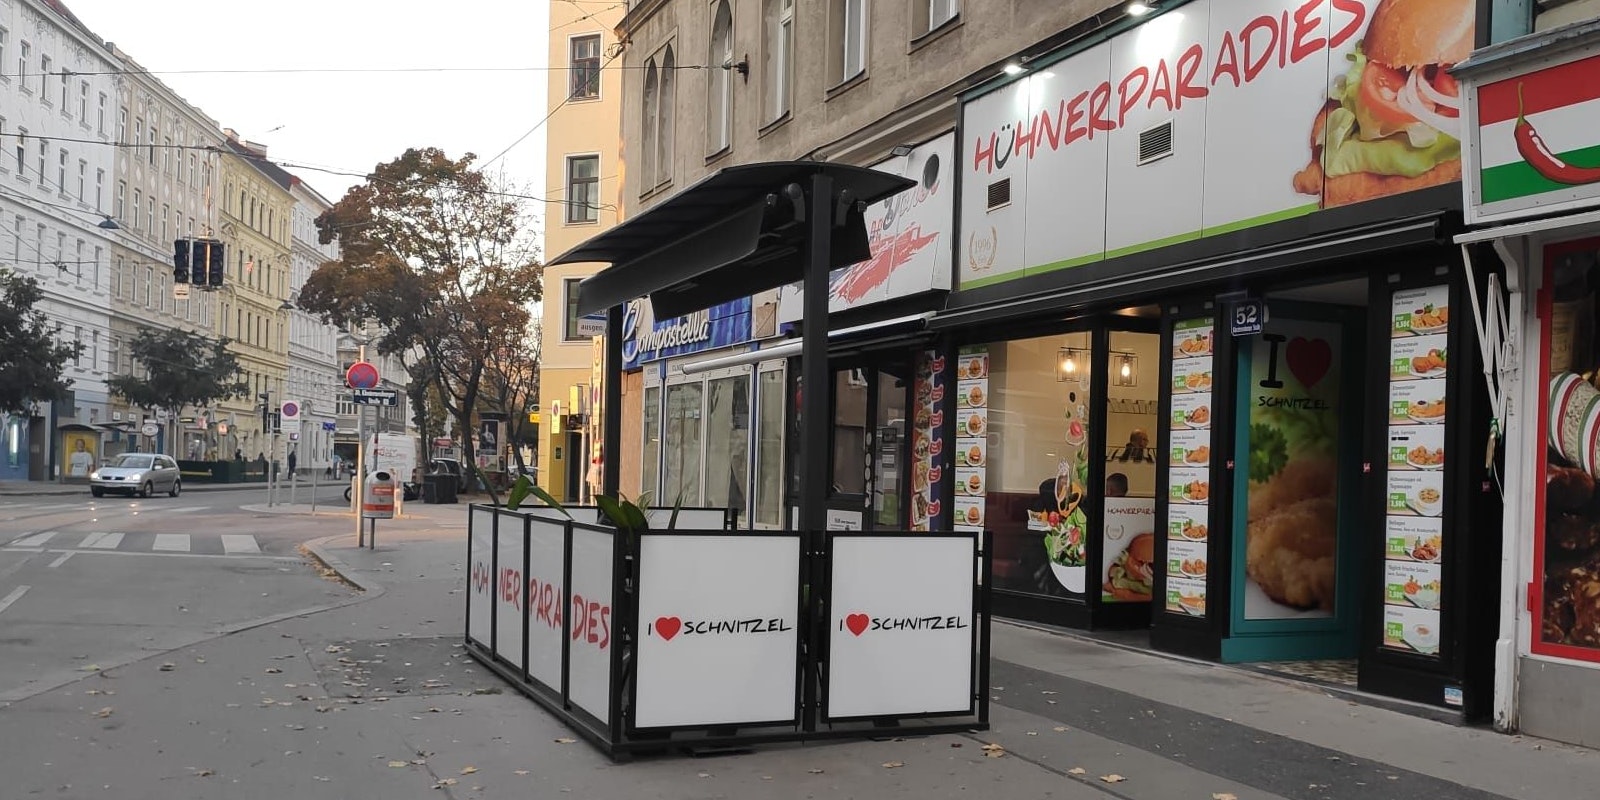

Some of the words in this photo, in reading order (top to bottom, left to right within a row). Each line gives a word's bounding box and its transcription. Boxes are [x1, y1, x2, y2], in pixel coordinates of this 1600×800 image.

[974, 0, 1366, 174] HÜHNERPARADIES
[622, 299, 710, 363] Compostella
[1236, 305, 1257, 325] 52
[1260, 334, 1287, 389] I
[1258, 396, 1331, 410] SCHNITZEL
[499, 567, 522, 612] NER
[529, 578, 562, 630] PARA
[572, 594, 610, 650] DIES
[647, 622, 652, 636] I
[683, 618, 792, 635] SCHNITZEL
[839, 620, 843, 632] I
[871, 616, 968, 631] SCHNITZEL
